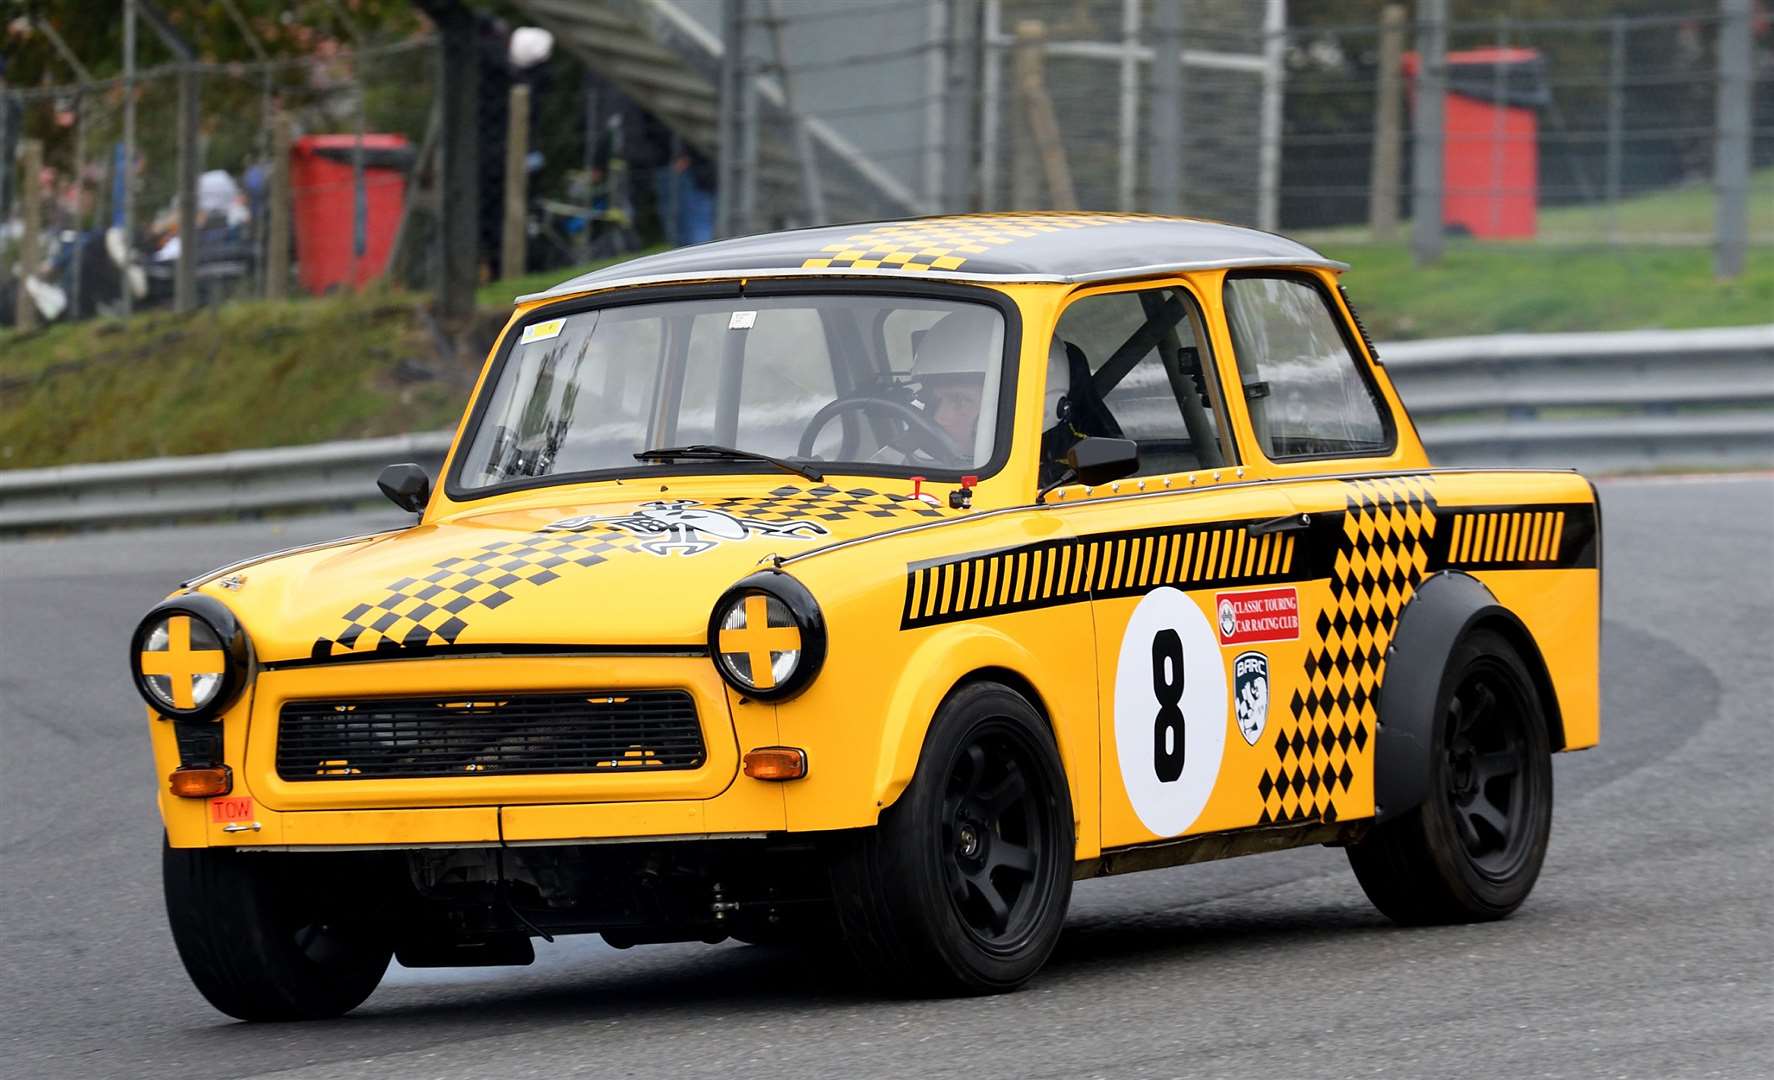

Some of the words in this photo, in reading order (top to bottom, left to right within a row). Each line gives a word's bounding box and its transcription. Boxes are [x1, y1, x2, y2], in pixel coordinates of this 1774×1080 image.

[1234, 599, 1264, 614] CLASSIC
[1264, 597, 1296, 611] TOURING
[1236, 618, 1250, 633] CAR
[1251, 617, 1278, 632] RACING
[1279, 616, 1298, 629] CLUB
[1237, 659, 1266, 677] BARC
[1152, 629, 1185, 783] 8
[213, 800, 249, 818] TOW
